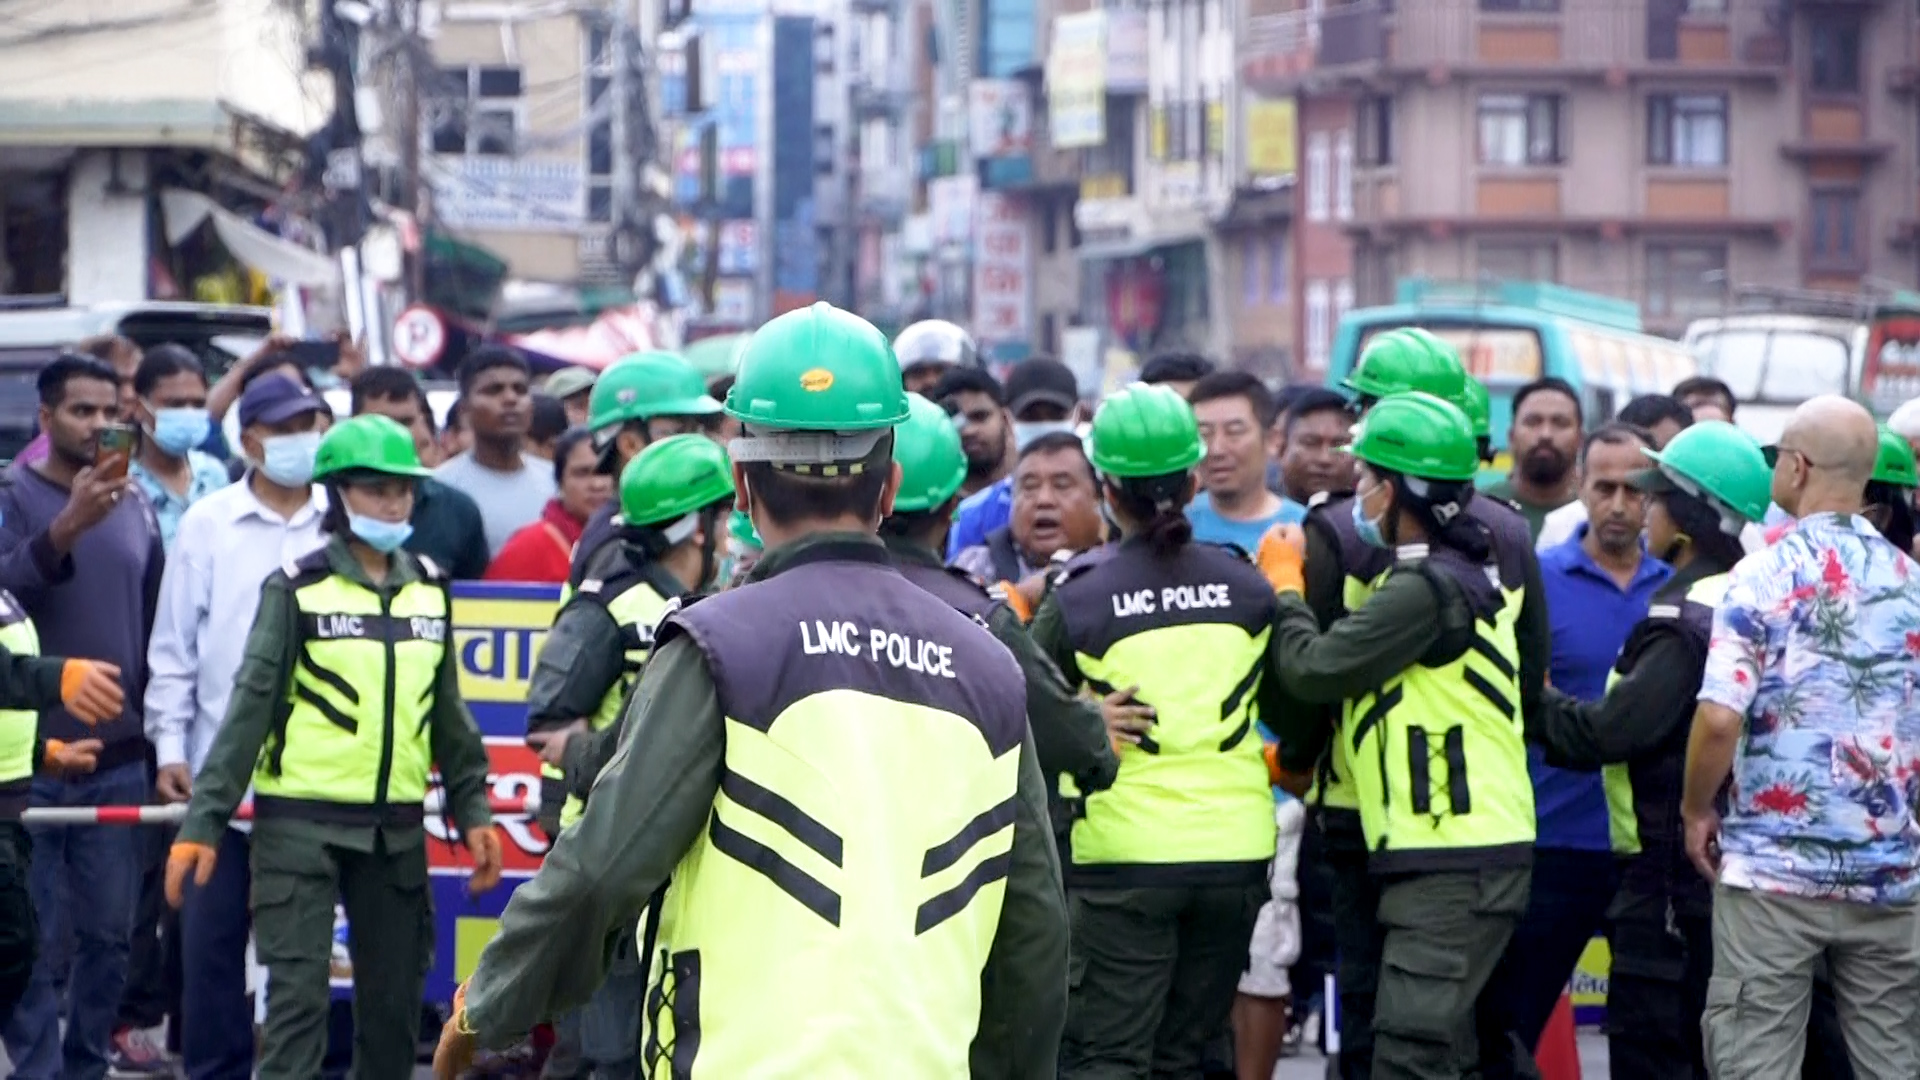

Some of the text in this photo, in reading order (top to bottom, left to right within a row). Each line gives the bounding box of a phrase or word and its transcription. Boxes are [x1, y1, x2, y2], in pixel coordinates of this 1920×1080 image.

[1112, 583, 1231, 617] LMC POLICE
[317, 614, 365, 638] LMC
[799, 620, 956, 678] LMC POLICE
